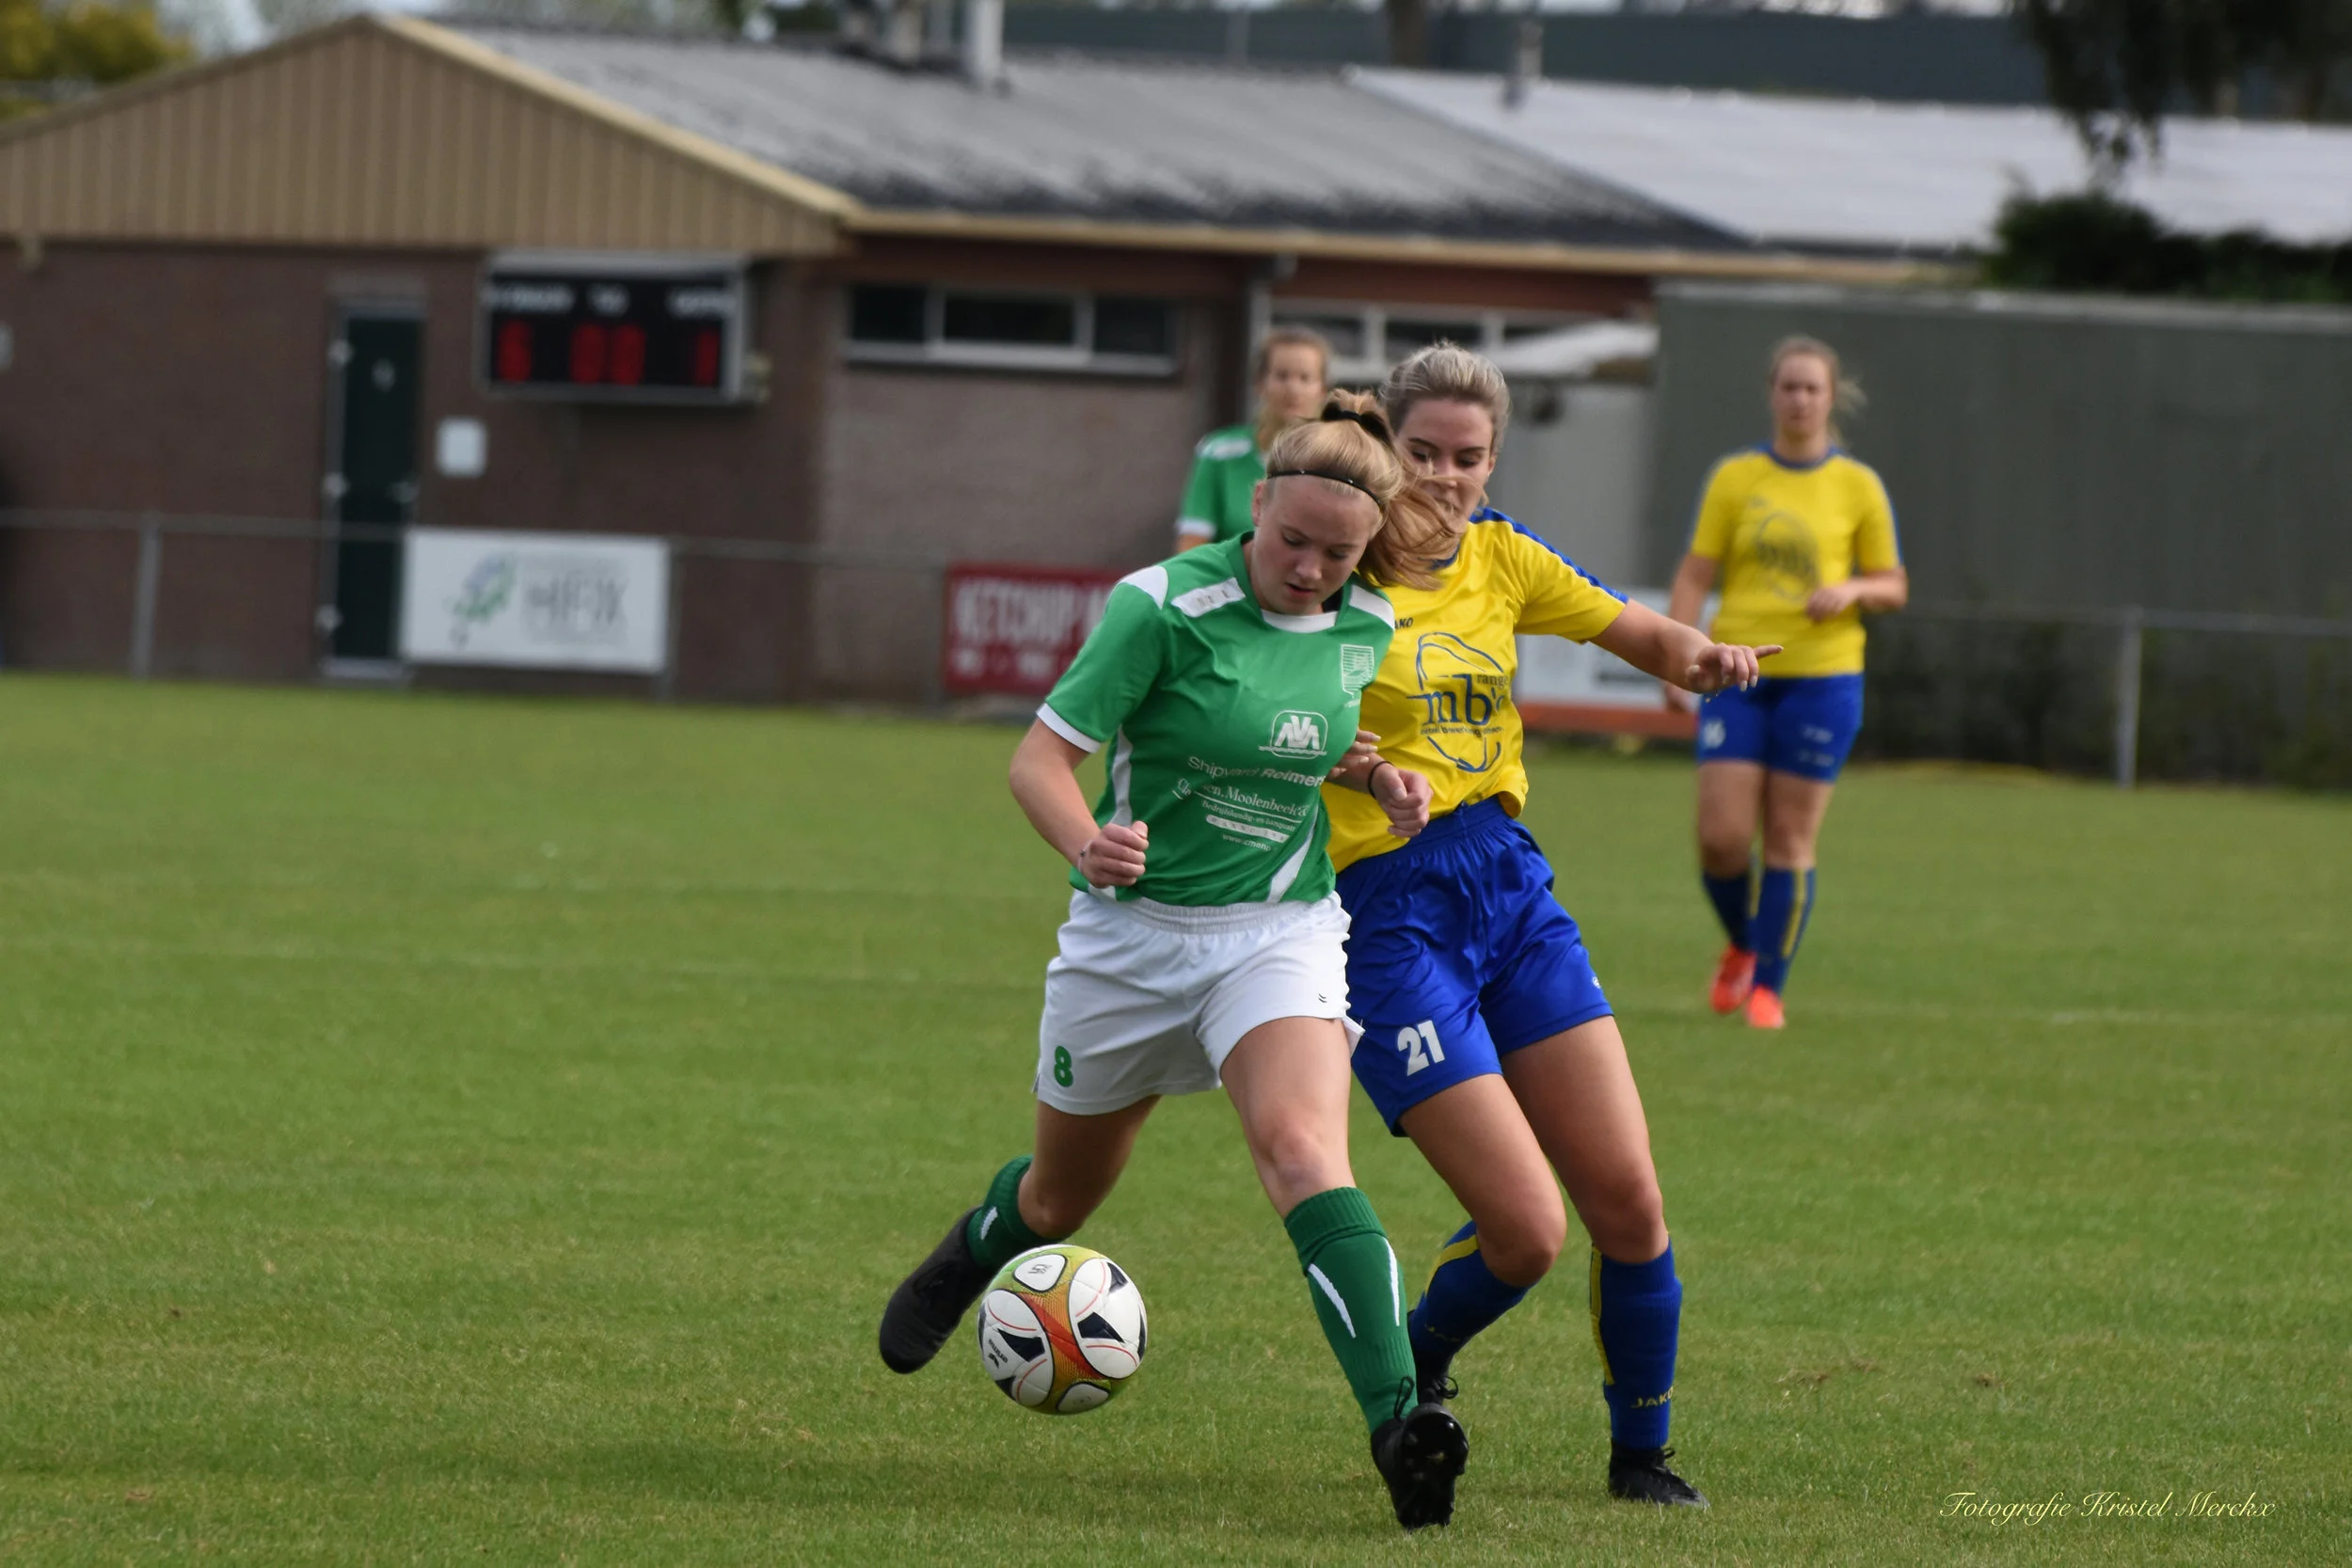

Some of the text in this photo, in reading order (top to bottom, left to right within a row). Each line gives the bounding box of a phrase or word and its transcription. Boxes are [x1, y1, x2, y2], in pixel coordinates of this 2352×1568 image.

[1227, 785, 1297, 814] Moolenbeek
[1054, 1045, 1074, 1087] 8
[1397, 1020, 1445, 1077] 21
[1630, 1386, 1674, 1409] JAKO
